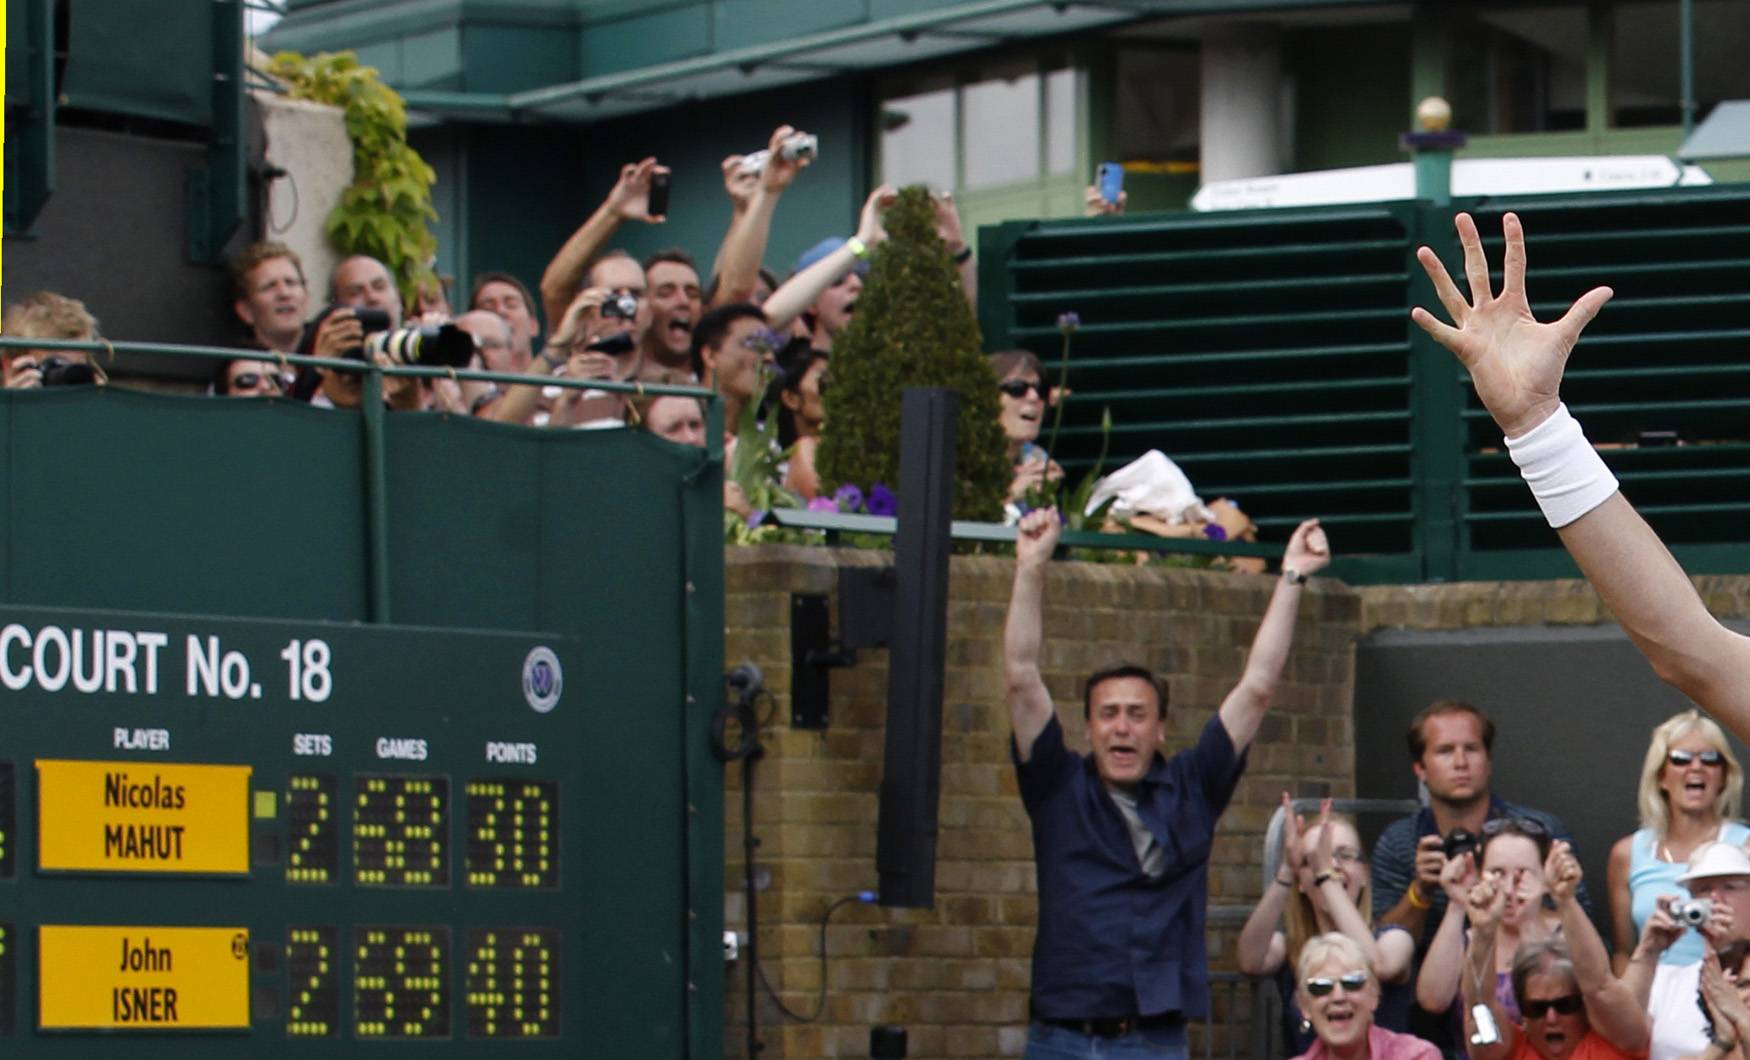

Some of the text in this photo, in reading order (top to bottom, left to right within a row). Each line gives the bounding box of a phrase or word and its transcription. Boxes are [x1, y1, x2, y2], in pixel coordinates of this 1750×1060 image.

[0, 624, 332, 702] COURT No. 18
[114, 727, 170, 750] PLAYER
[293, 733, 332, 756] SETS
[376, 737, 428, 760] GAMES
[485, 741, 537, 764] POINTS
[105, 772, 185, 809] Nicolas
[105, 824, 185, 860] MAHUT
[286, 776, 549, 887] 2 68 30
[120, 936, 172, 972] John
[286, 929, 549, 1036] 2 69 40
[113, 986, 178, 1022] ISNER
